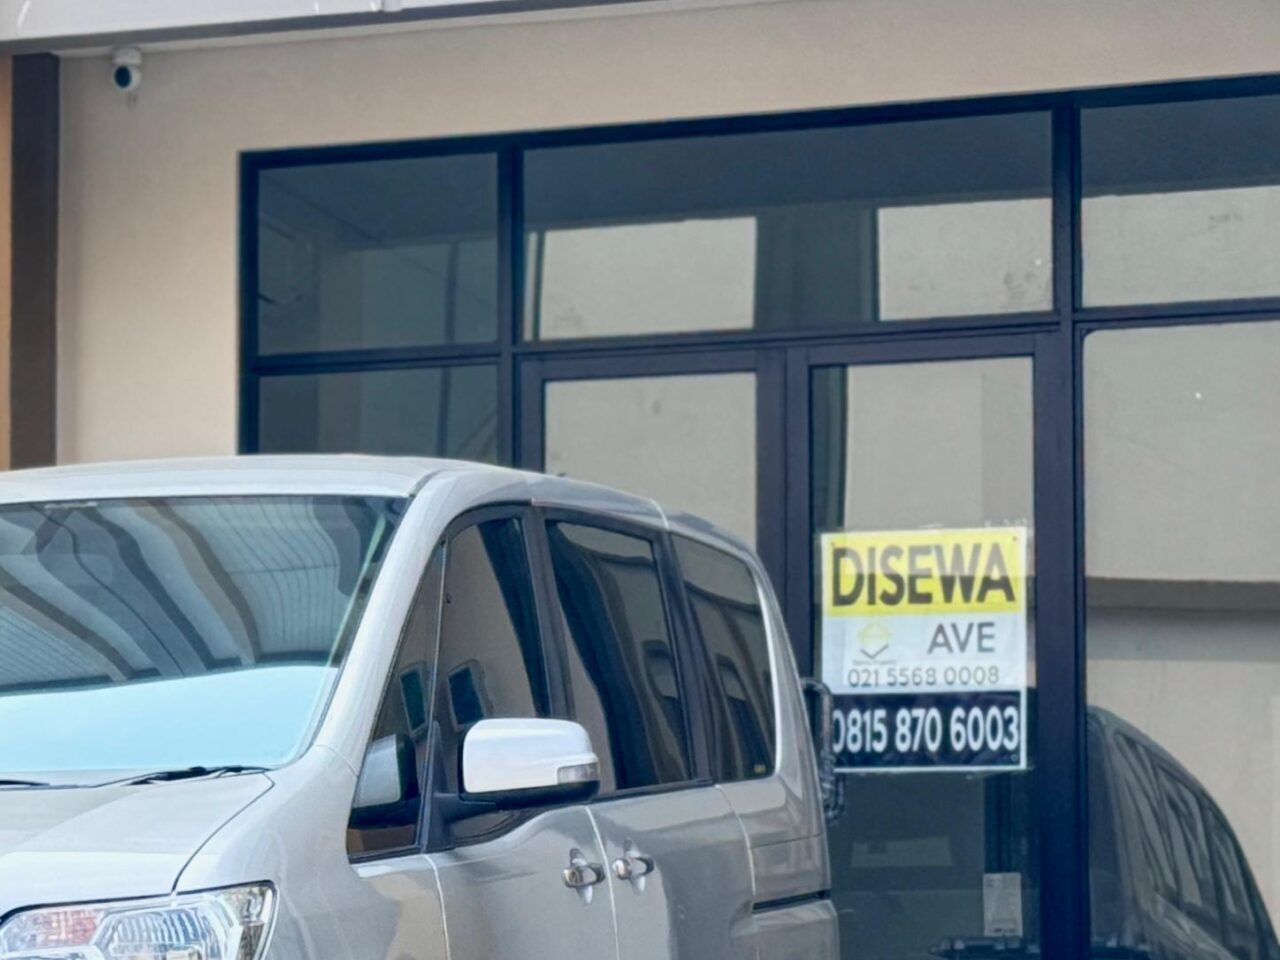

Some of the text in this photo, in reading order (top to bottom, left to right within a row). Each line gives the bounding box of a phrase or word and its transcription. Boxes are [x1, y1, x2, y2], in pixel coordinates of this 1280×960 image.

[832, 542, 1016, 607] DISEWA
[927, 622, 996, 655] AVE
[847, 665, 1000, 688] 021 5568 0008
[833, 705, 1020, 754] 0815 870 6003
